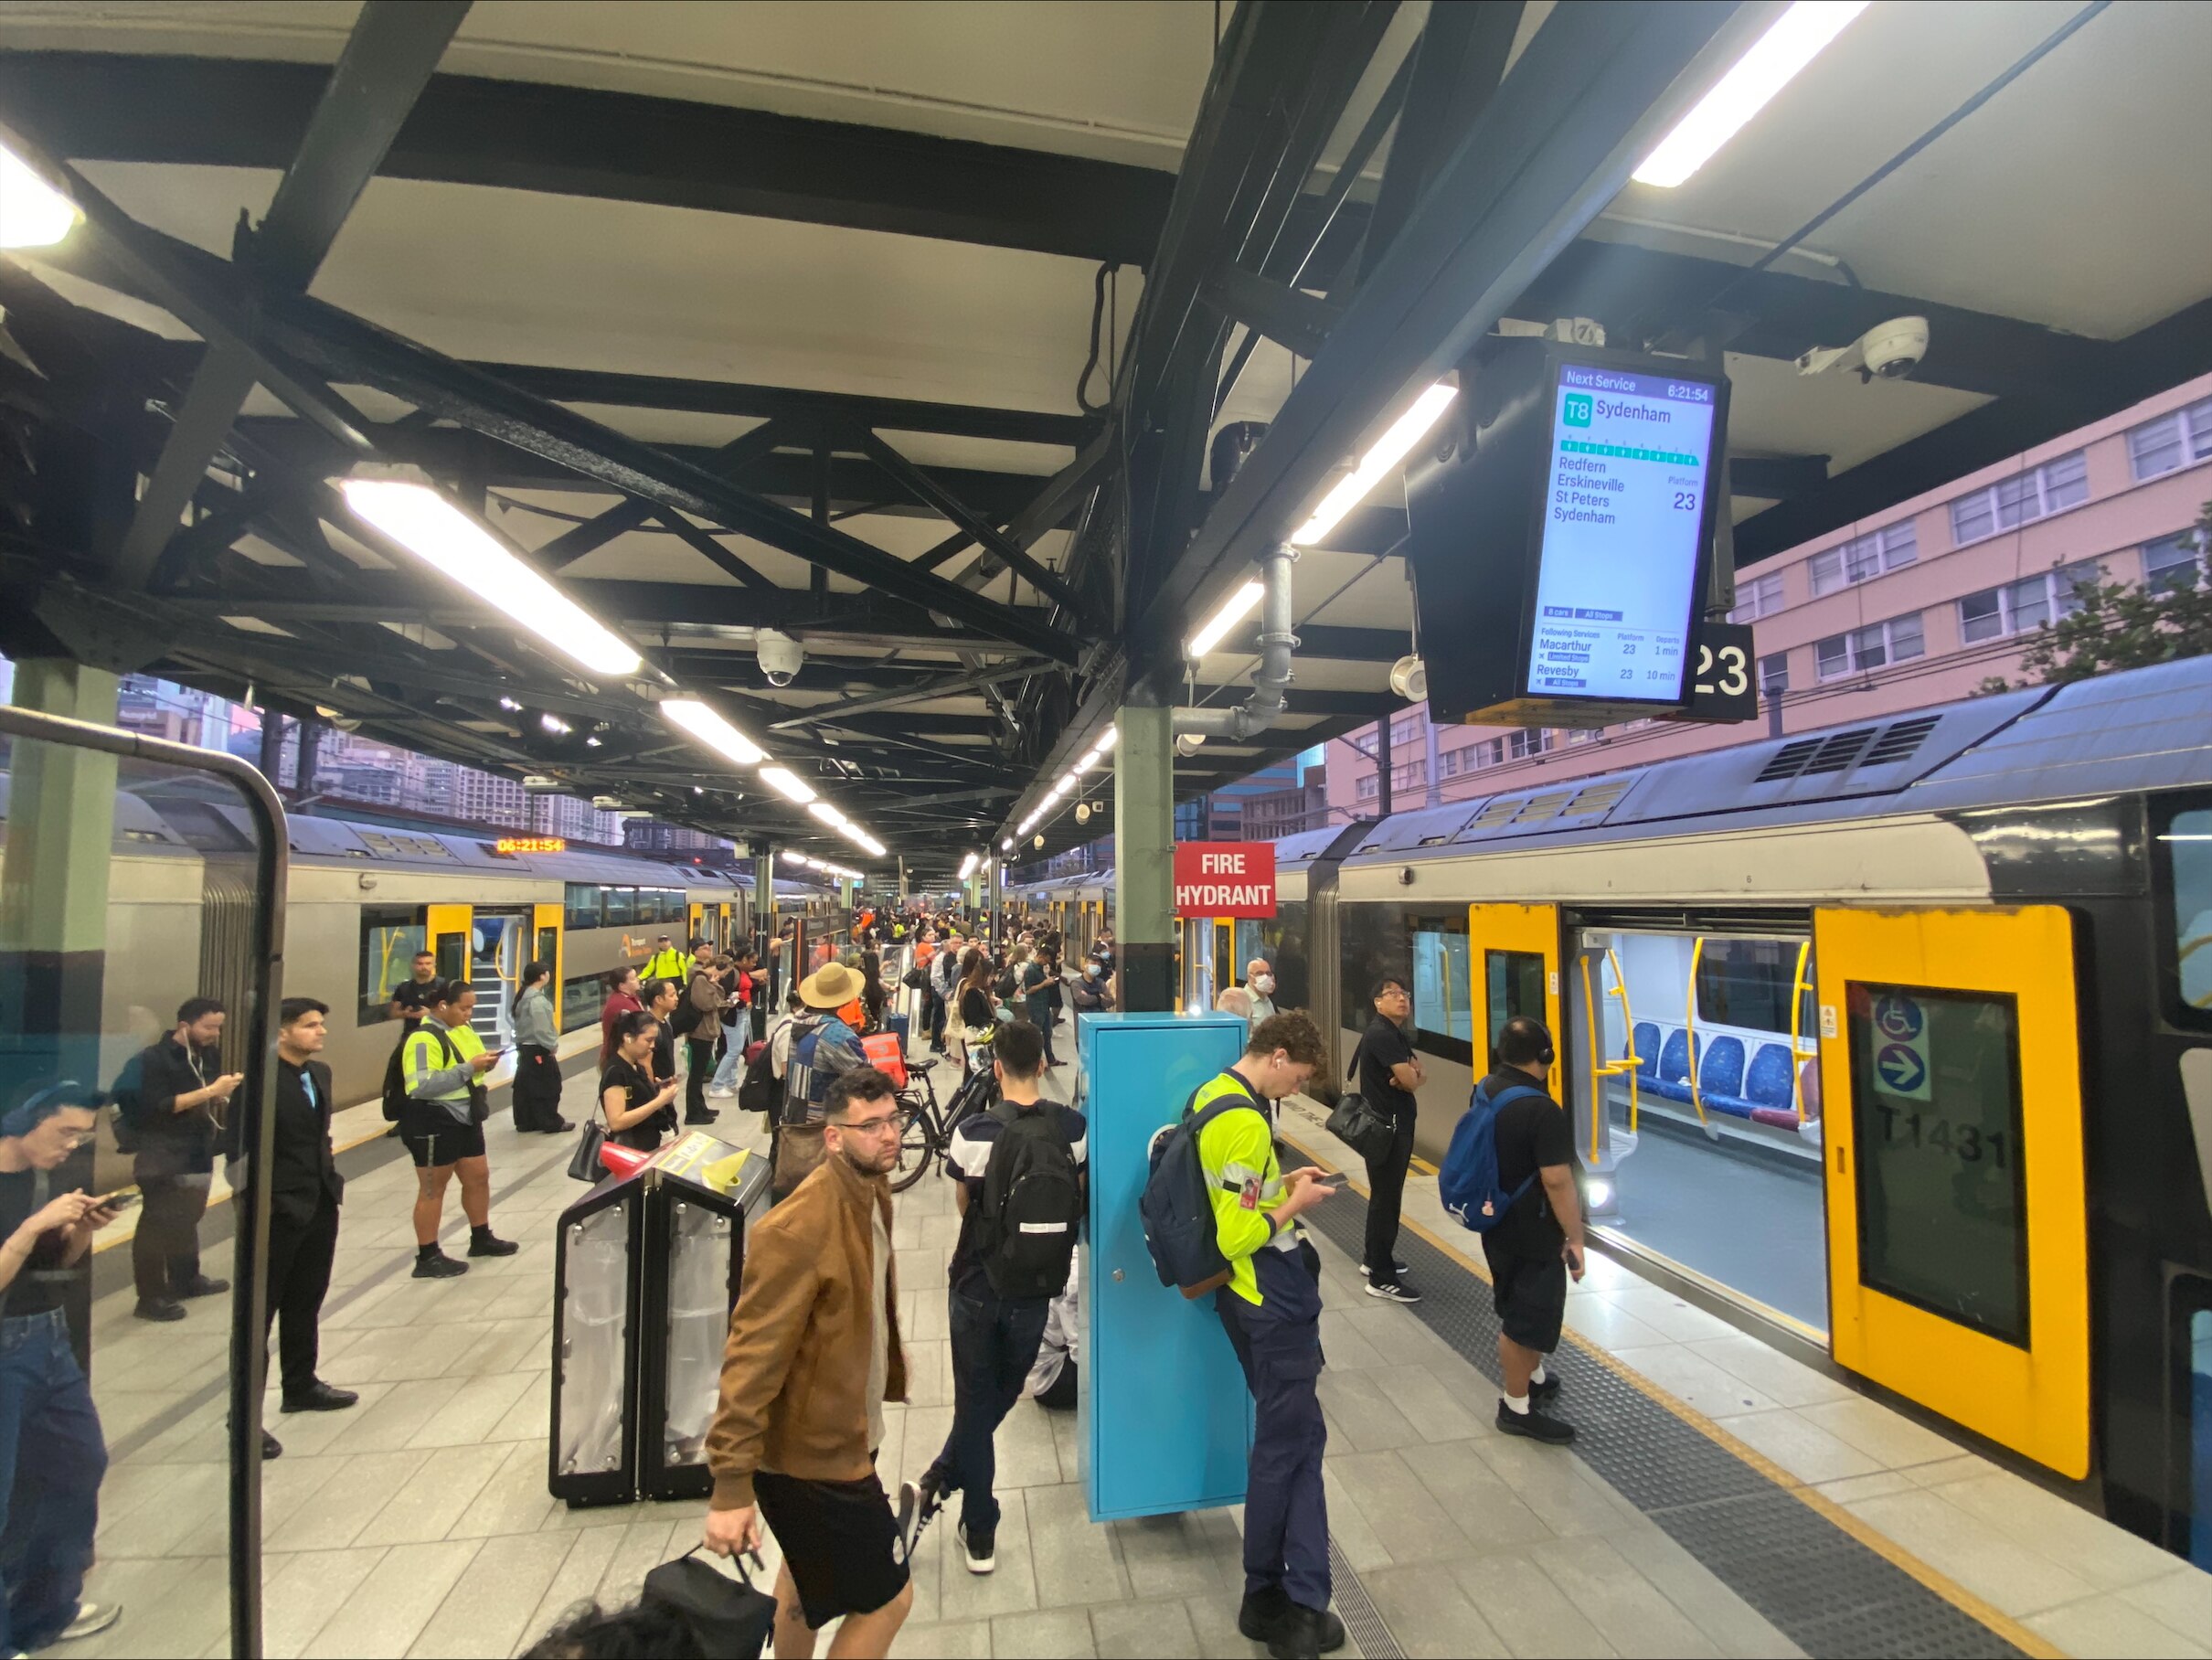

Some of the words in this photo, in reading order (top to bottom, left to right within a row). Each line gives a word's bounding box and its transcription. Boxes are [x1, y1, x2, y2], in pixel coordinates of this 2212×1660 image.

[1567, 371, 1593, 387] Next
[1596, 375, 1636, 391] Service
[1667, 385, 1708, 401] 6:21:54
[1568, 400, 1589, 420] T8
[1596, 400, 1671, 423] Sydenham
[1559, 456, 1606, 474] Redfern
[1558, 474, 1625, 492] Erskineville
[1668, 475, 1698, 487] Platform
[1556, 490, 1569, 503] St
[1571, 492, 1610, 507] Peters
[1674, 492, 1696, 511] 23
[1554, 507, 1615, 525] Sydenham
[1585, 611, 1594, 619] All
[1595, 612, 1613, 620] Stops
[1541, 627, 1572, 638] Following
[1573, 630, 1601, 639] Services
[1617, 633, 1644, 642] Platform
[1539, 638, 1592, 652] Macarthur
[1622, 644, 1636, 654] 23
[1663, 646, 1678, 656] min
[1537, 664, 1579, 678] Revesby
[1620, 669, 1633, 679] 23
[1646, 670, 1658, 680] 10
[1659, 671, 1675, 680] min
[1695, 644, 1748, 696] 23
[497, 838, 565, 852] 06:21:54
[1202, 853, 1246, 874] FIRE
[1175, 885, 1271, 906] HYDRANT
[1877, 1104, 2006, 1169] T1431
